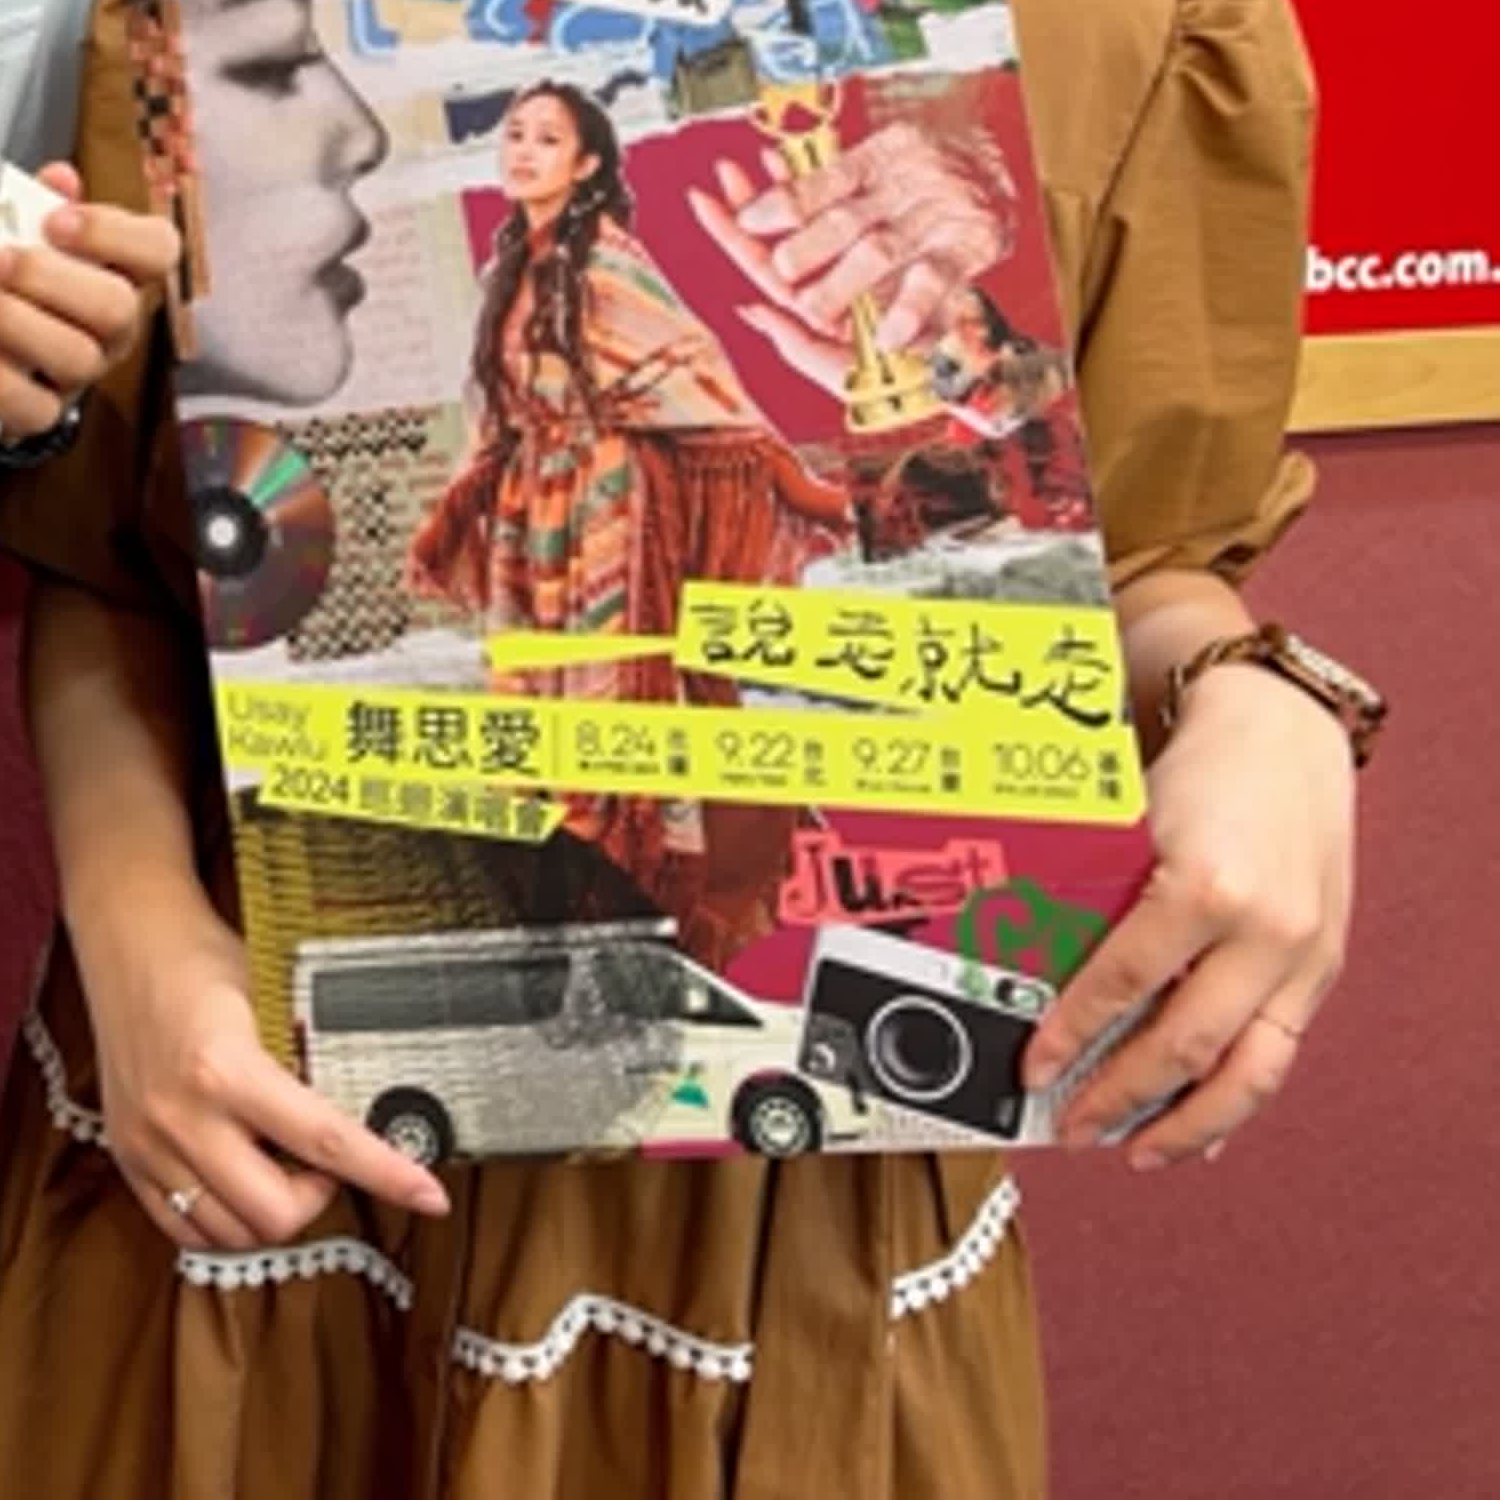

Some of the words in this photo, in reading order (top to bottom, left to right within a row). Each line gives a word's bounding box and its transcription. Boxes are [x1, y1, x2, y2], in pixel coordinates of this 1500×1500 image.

[346, 700, 541, 777] 舞思愛
[575, 720, 657, 756] 8.24
[714, 731, 797, 768] 9.22
[851, 737, 932, 775] 9.27
[271, 762, 350, 804] 2024
